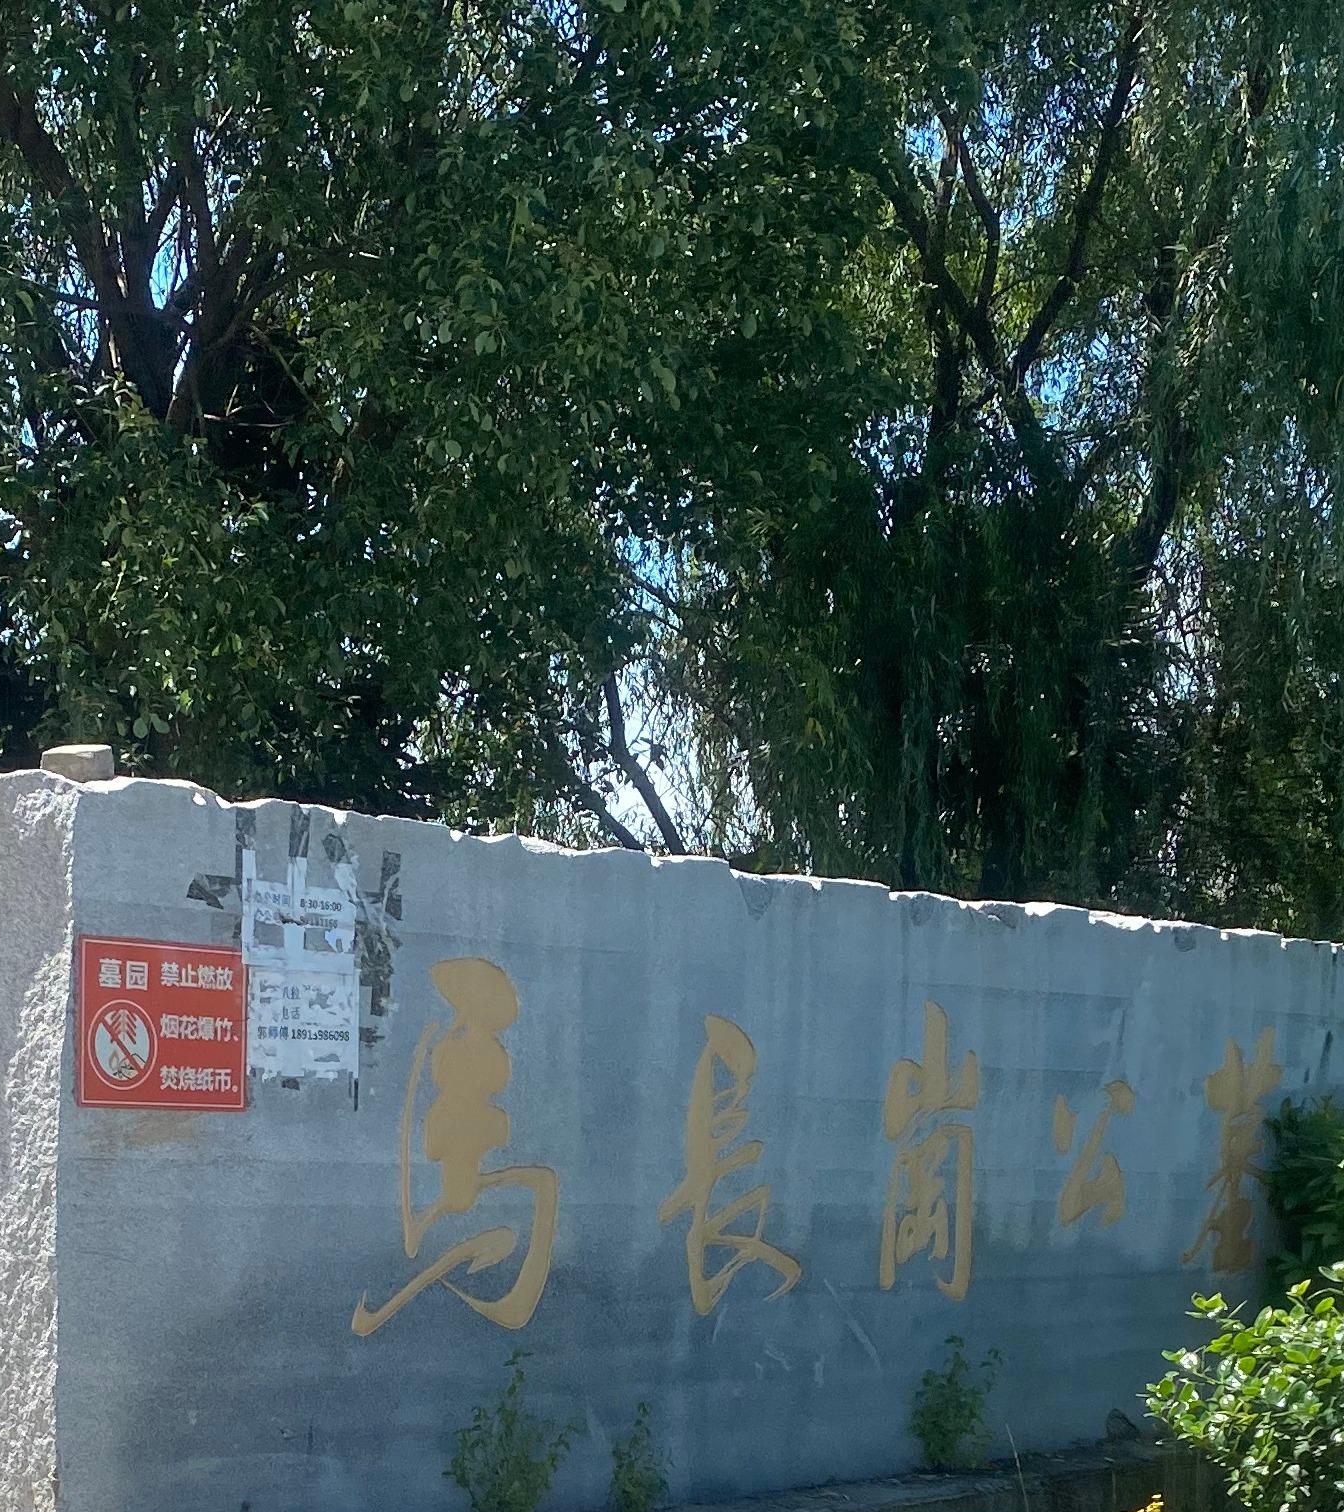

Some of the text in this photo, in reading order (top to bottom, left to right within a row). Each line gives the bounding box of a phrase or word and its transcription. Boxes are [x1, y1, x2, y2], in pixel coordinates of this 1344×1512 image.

[98, 958, 233, 991] 墓园 禁止燃放
[159, 1013, 239, 1042] 烟花爆竹、
[159, 1064, 239, 1093] 焚烧纸币。
